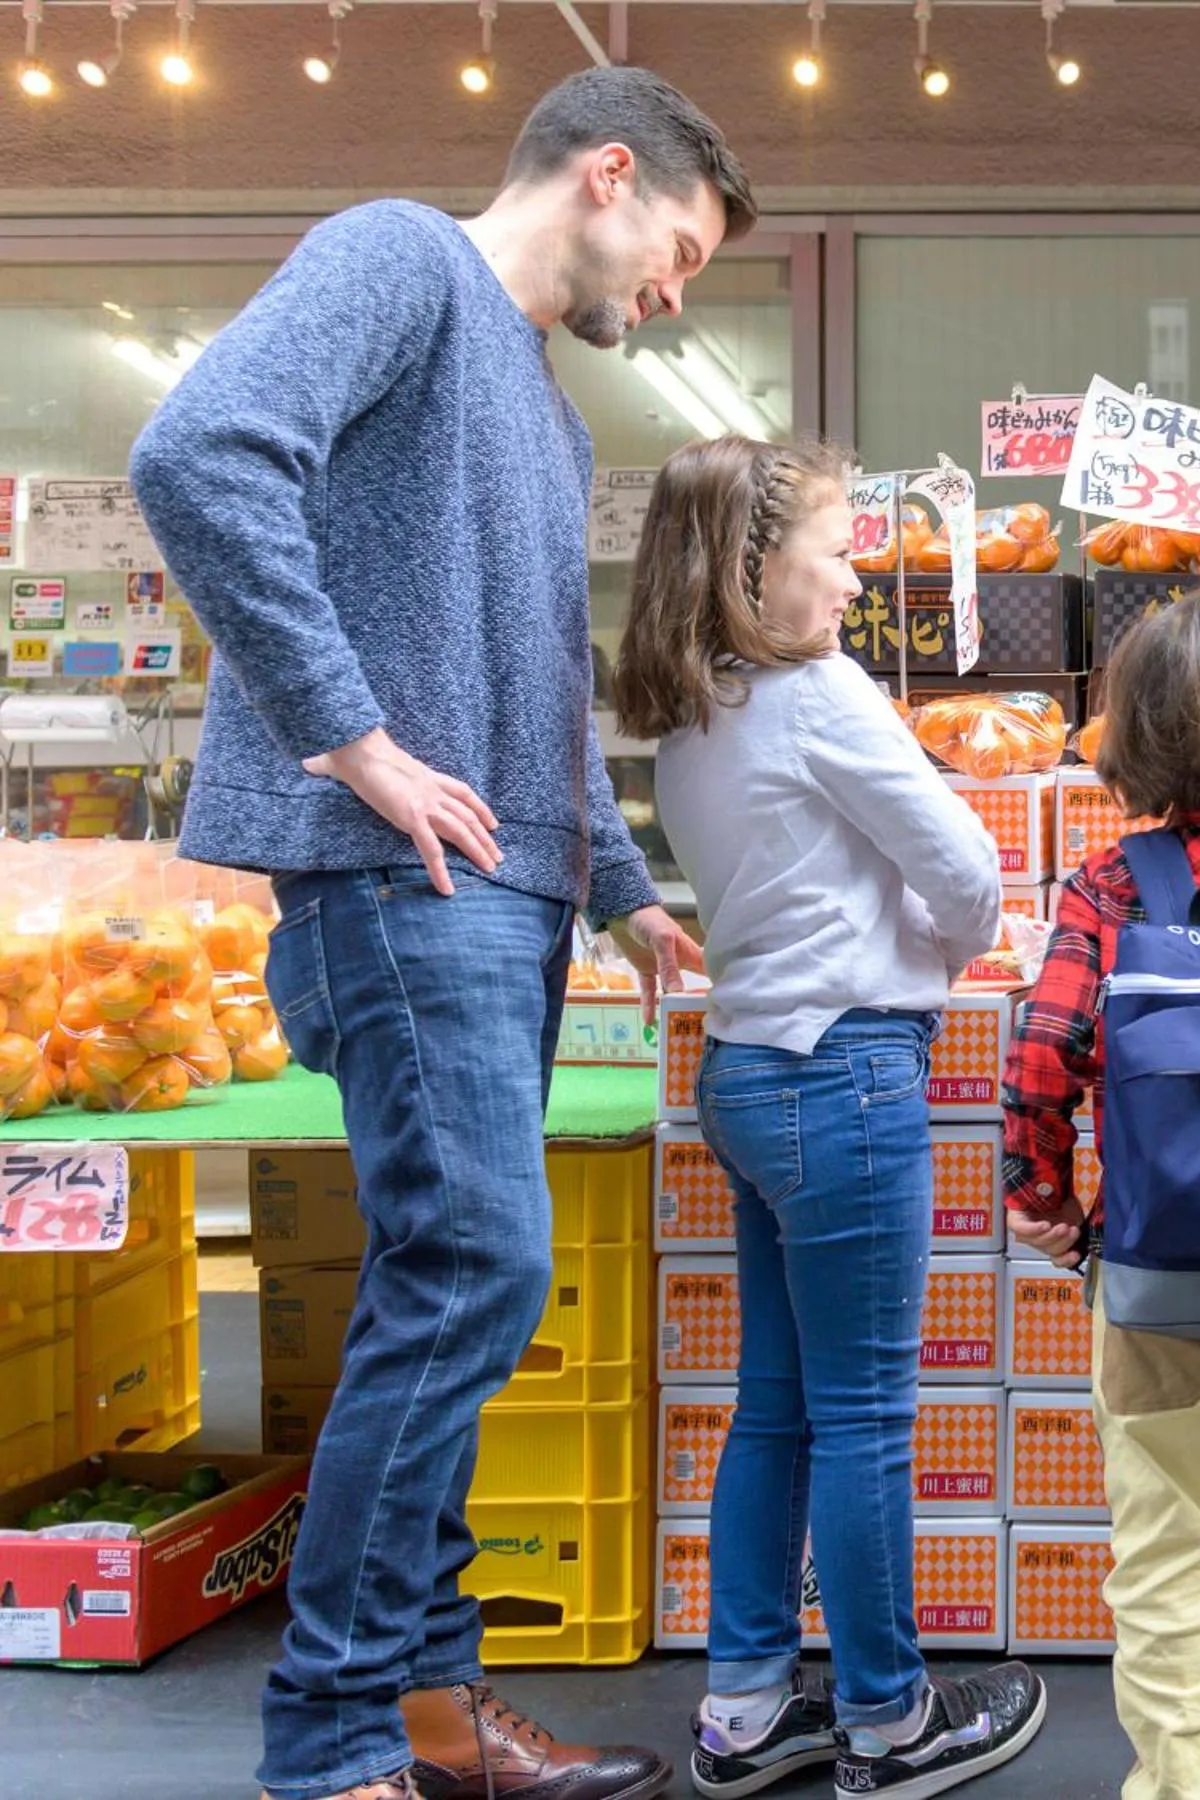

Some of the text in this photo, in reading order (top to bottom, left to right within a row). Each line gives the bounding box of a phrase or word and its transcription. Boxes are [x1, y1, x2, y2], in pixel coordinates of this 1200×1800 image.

[988, 406, 1078, 436] 味ピカみかん
[844, 585, 983, 662] 味ピ
[927, 1081, 991, 1100] 川上蜜柑
[2, 1155, 105, 1195] ライム
[936, 1213, 986, 1231] 上蜜柑
[922, 1343, 988, 1361] 川上蜜柑
[923, 1477, 989, 1494] 川上蜜柑
[921, 1610, 987, 1627] 川上蜜柑
